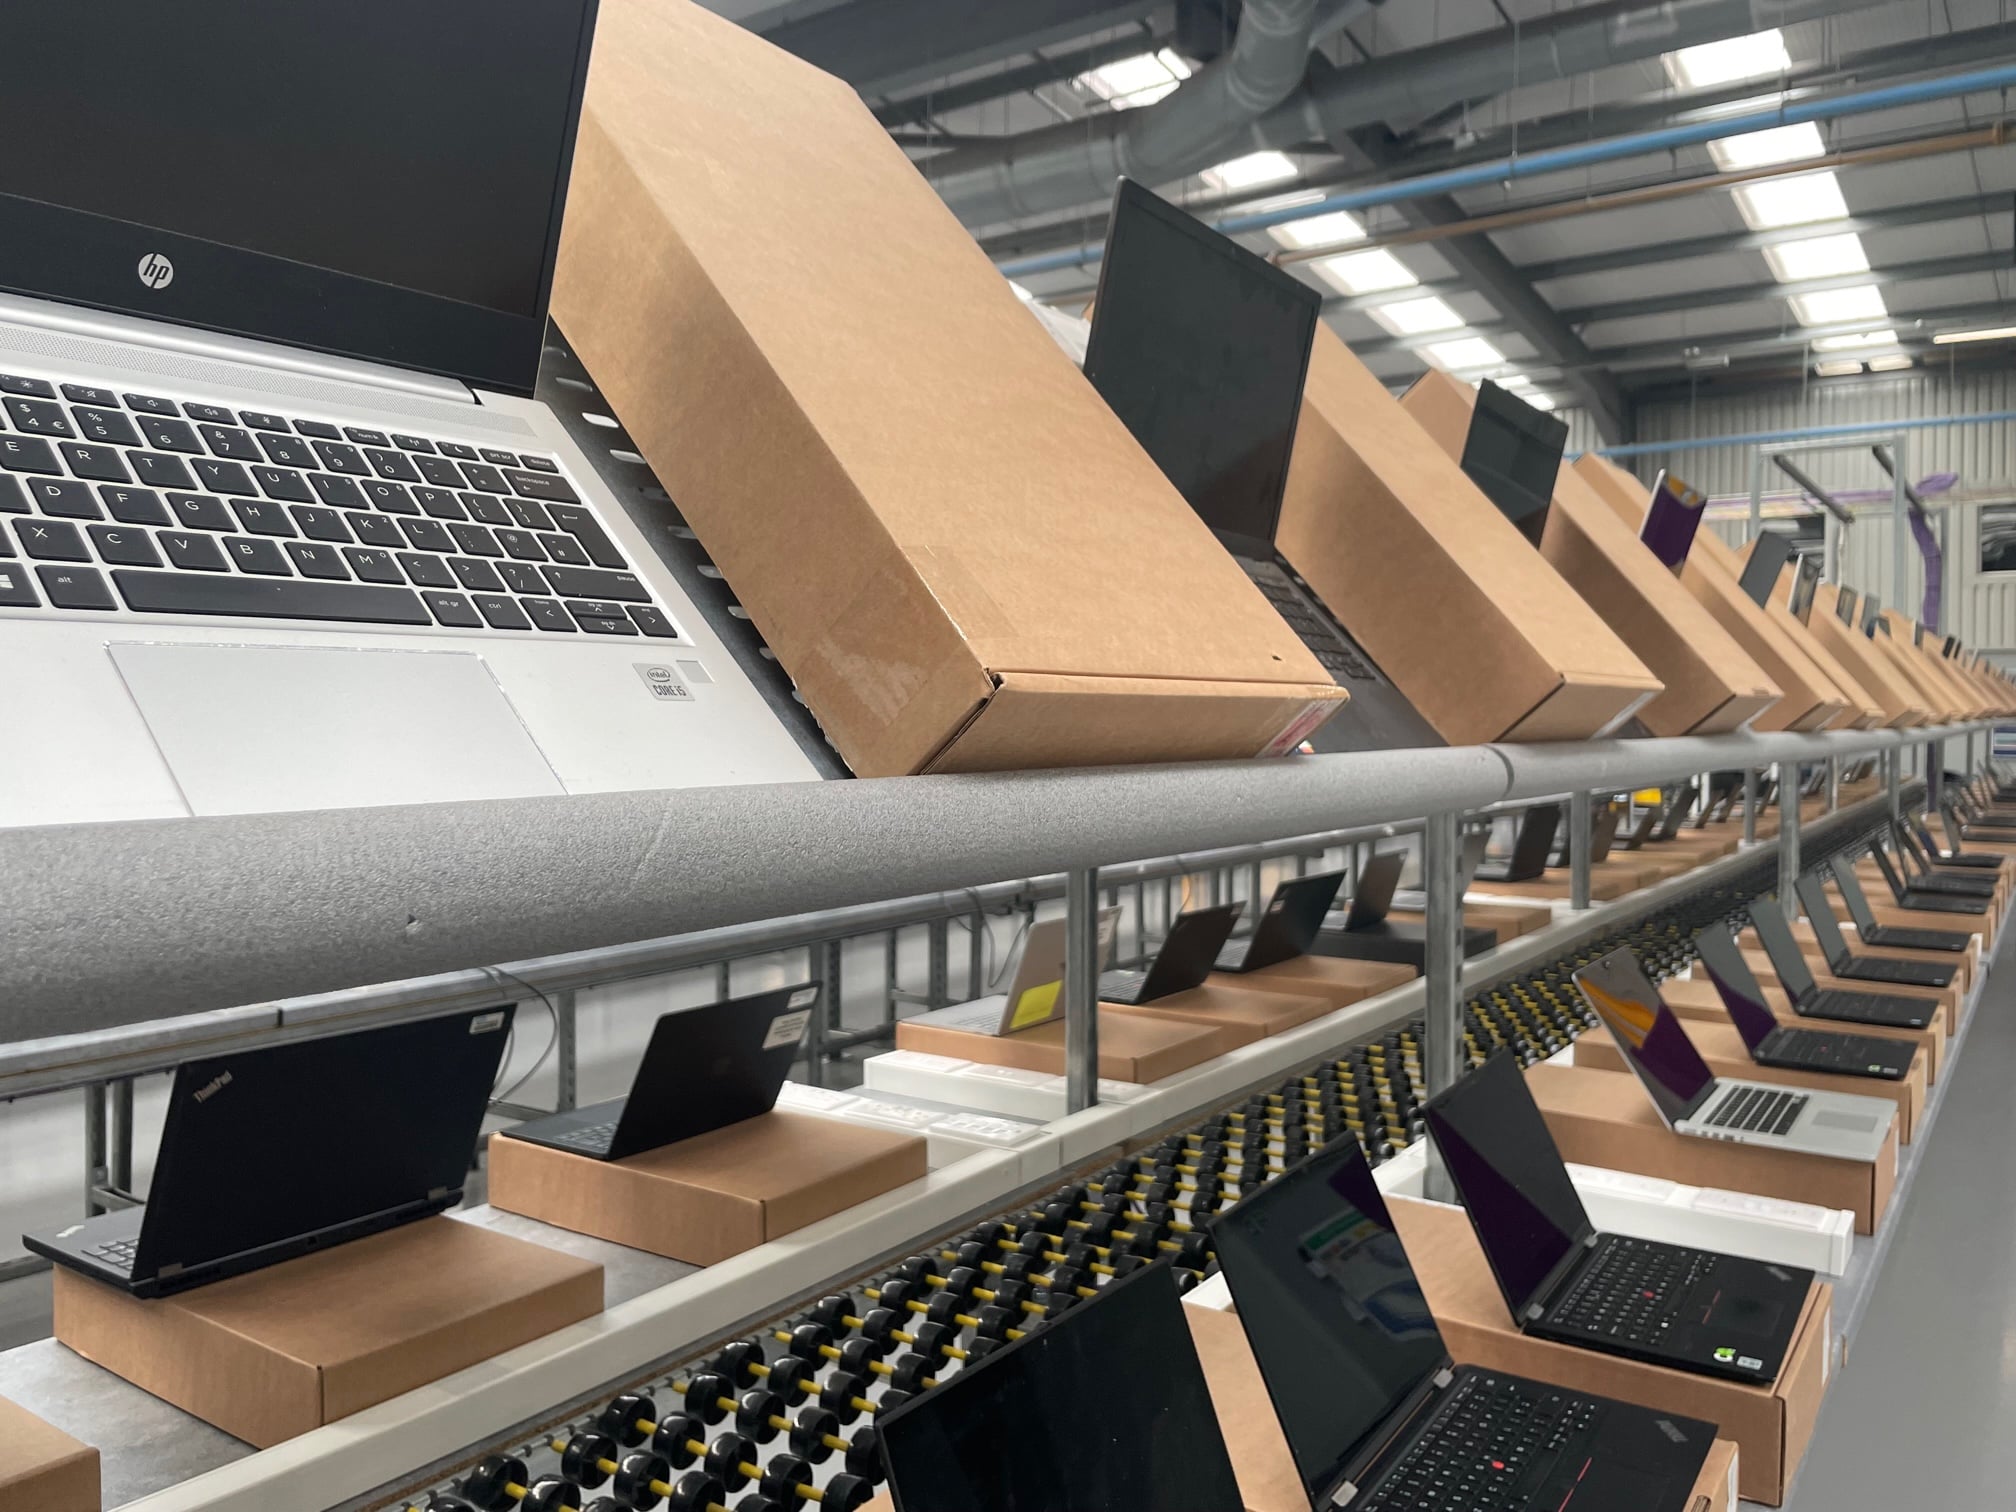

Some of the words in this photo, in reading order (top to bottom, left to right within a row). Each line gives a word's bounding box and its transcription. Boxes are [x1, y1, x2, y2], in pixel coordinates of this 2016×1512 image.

[143, 253, 170, 288] hp
[19, 403, 31, 413] $
[28, 417, 39, 426] 4
[87, 412, 103, 422] %
[52, 421, 65, 430] €
[95, 425, 107, 435] 5
[160, 434, 172, 444] 6
[215, 430, 226, 439] &
[5, 440, 20, 452] E
[221, 442, 230, 451] 7
[325, 445, 333, 455] (
[76, 449, 92, 460] R
[279, 450, 290, 460] 8
[376, 453, 384, 462] )
[142, 457, 153, 468] T
[333, 458, 344, 467] 9
[207, 465, 219, 475] Y
[384, 465, 395, 474] 0
[266, 472, 280, 483] U
[515, 475, 550, 486] backspace
[323, 479, 330, 489] I
[45, 485, 62, 496] D
[376, 486, 389, 496] O
[116, 492, 129, 503] F
[425, 492, 435, 501] P
[184, 500, 200, 511] G
[246, 506, 261, 517] H
[307, 513, 315, 522] J
[360, 519, 374, 529] K
[412, 524, 424, 534] L
[31, 526, 49, 538] X
[106, 533, 122, 544] C
[174, 538, 188, 549] V
[239, 544, 254, 555] B
[300, 549, 316, 560] N
[358, 554, 374, 565] M
[57, 576, 73, 584] alt
[652, 685, 677, 696] CORE
[674, 685, 687, 696] i5
